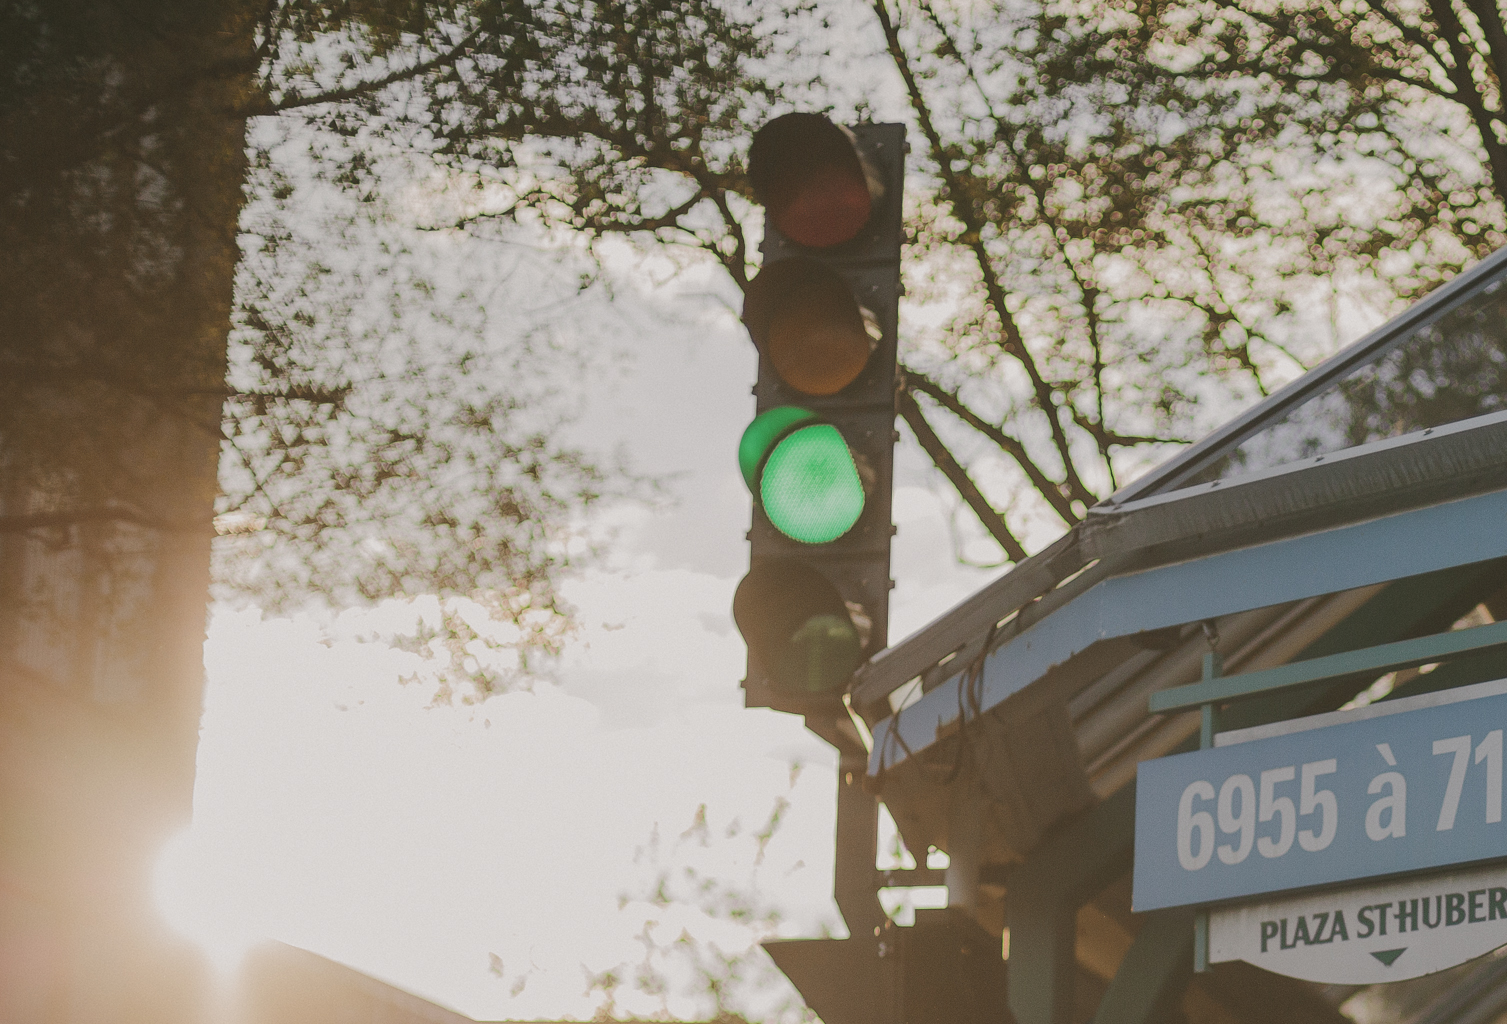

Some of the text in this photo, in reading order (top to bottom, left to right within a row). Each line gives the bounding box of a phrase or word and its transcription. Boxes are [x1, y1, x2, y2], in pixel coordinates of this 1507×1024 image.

[1177, 758, 1338, 871] 6955
[1364, 743, 1407, 842] à
[1259, 912, 1349, 953] PLAZA
